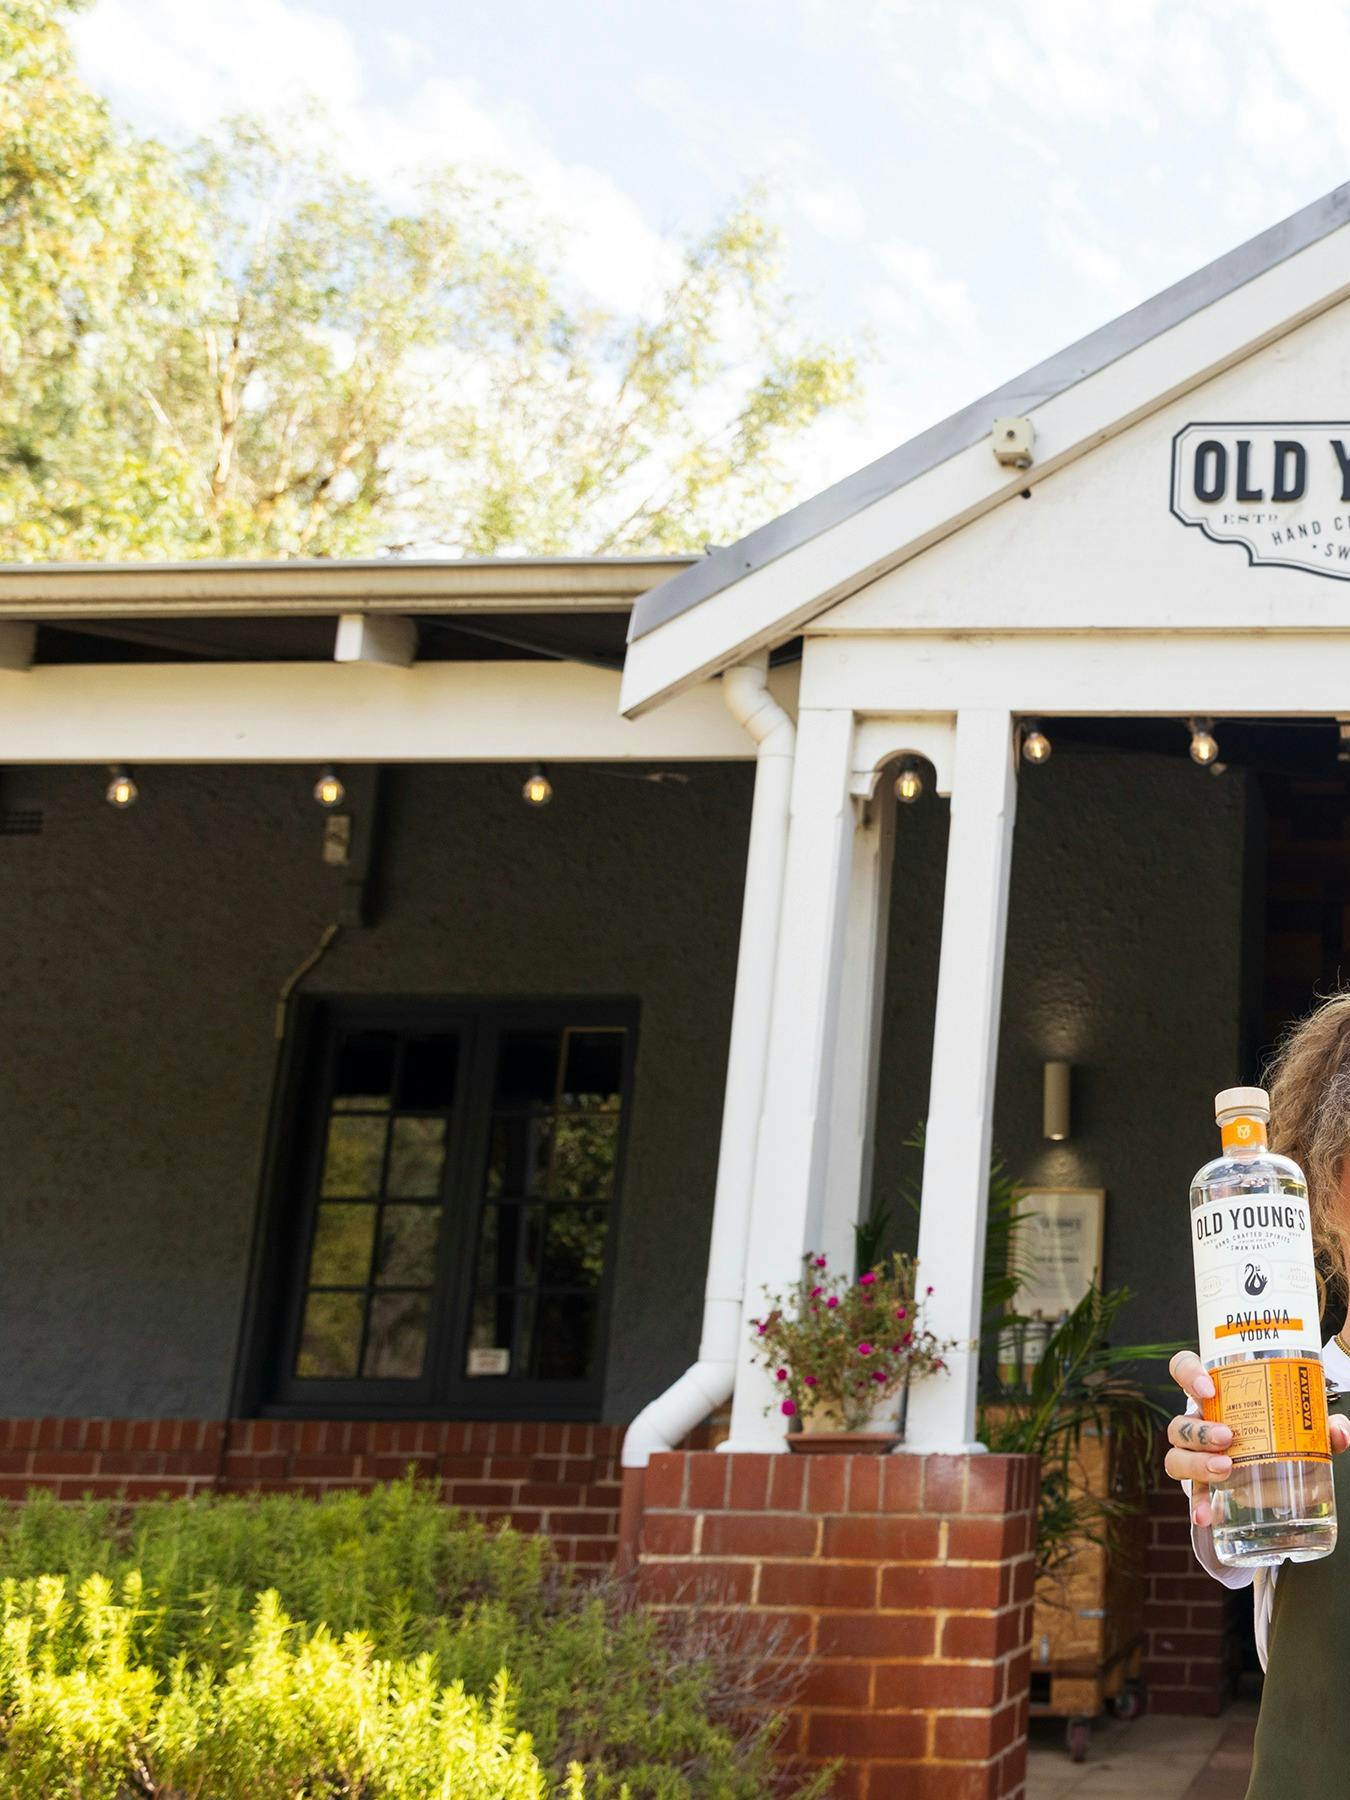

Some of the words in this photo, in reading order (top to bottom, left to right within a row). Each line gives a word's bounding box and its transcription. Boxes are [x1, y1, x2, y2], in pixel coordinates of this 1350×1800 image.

[1193, 439, 1308, 503] OLD
[1271, 520, 1322, 546] HAND
[1196, 1212, 1223, 1240] OLD
[1229, 1206, 1306, 1231] YOUNG'S
[1226, 1309, 1290, 1330] PAVLOVA
[1240, 1328, 1280, 1342] VODKA
[1299, 1368, 1313, 1430] PAVLOVA
